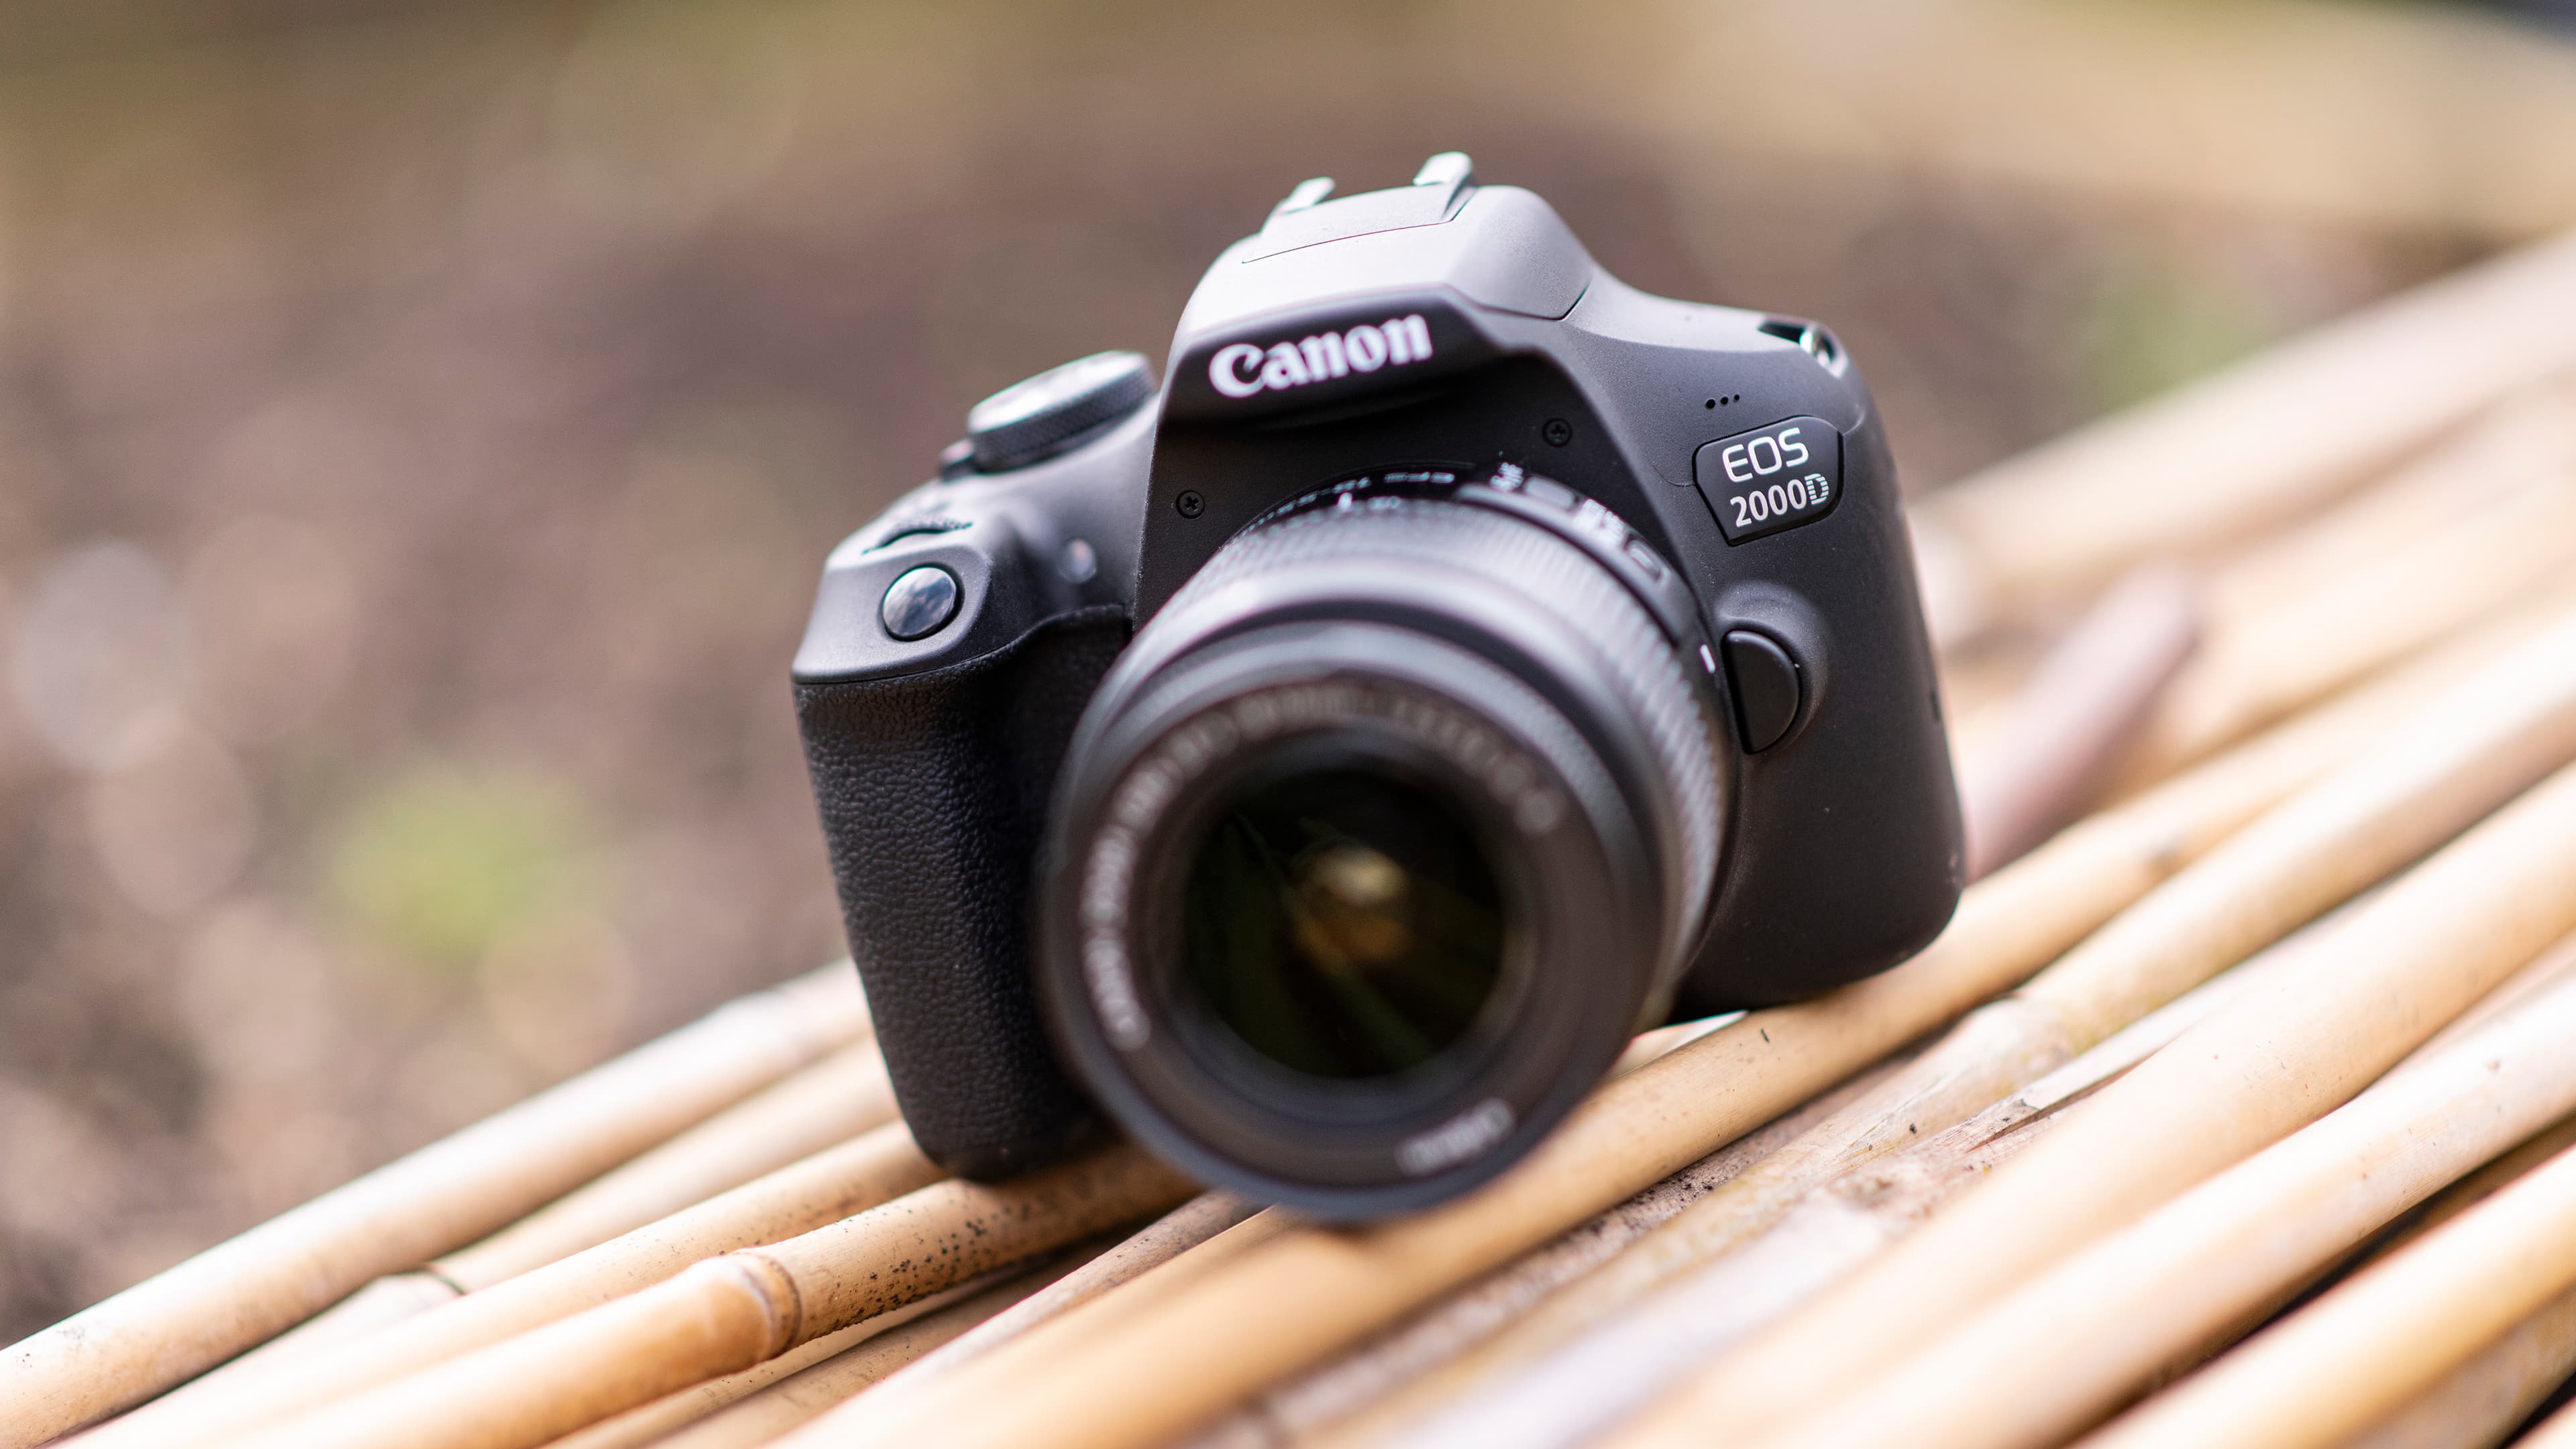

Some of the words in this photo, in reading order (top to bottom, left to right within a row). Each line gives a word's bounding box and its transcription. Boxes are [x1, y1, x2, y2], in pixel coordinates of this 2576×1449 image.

[1210, 314, 1432, 398] Canon
[1722, 427, 1809, 482] EOS
[1730, 473, 1829, 527] 2000D
